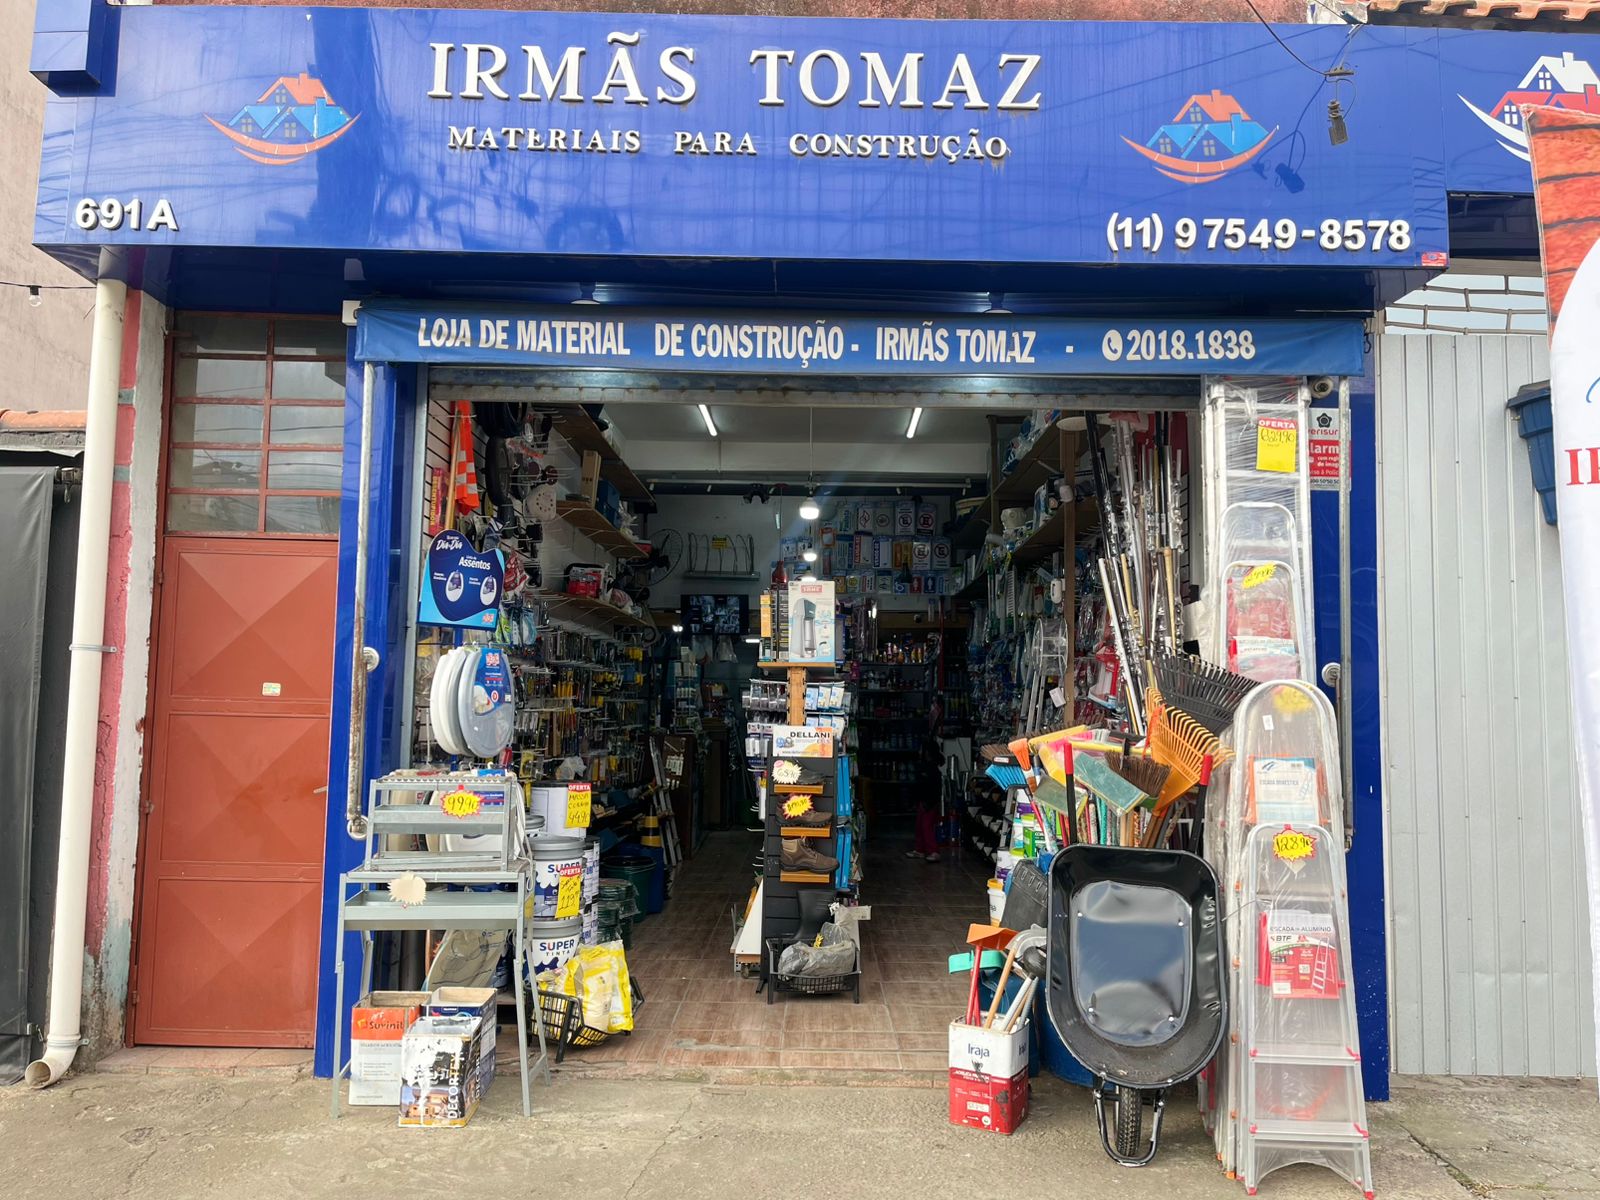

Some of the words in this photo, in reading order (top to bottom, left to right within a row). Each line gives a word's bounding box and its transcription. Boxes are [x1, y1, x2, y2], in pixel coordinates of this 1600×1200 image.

[427, 31, 697, 103] IRMÃS
[749, 49, 1042, 109] TOMAZ
[448, 125, 642, 152] MATERIAIS
[673, 131, 756, 155] PARA
[789, 128, 1008, 163] CONSTRUÇÃO
[1106, 212, 1164, 252] (11)
[418, 318, 471, 348] LOJA
[478, 319, 509, 349] DE
[516, 320, 631, 355] MATERIAL
[655, 323, 685, 356] DE
[691, 319, 844, 369] CONSTRUÇÃO
[876, 321, 949, 362] IRMÃS
[956, 328, 1037, 363] TOMAZ
[1126, 329, 1256, 361] 2018.1838
[1258, 419, 1296, 428] OFERTA
[1310, 442, 1340, 454] larm
[458, 556, 491, 570] Assentos
[539, 939, 575, 952] SUPER
